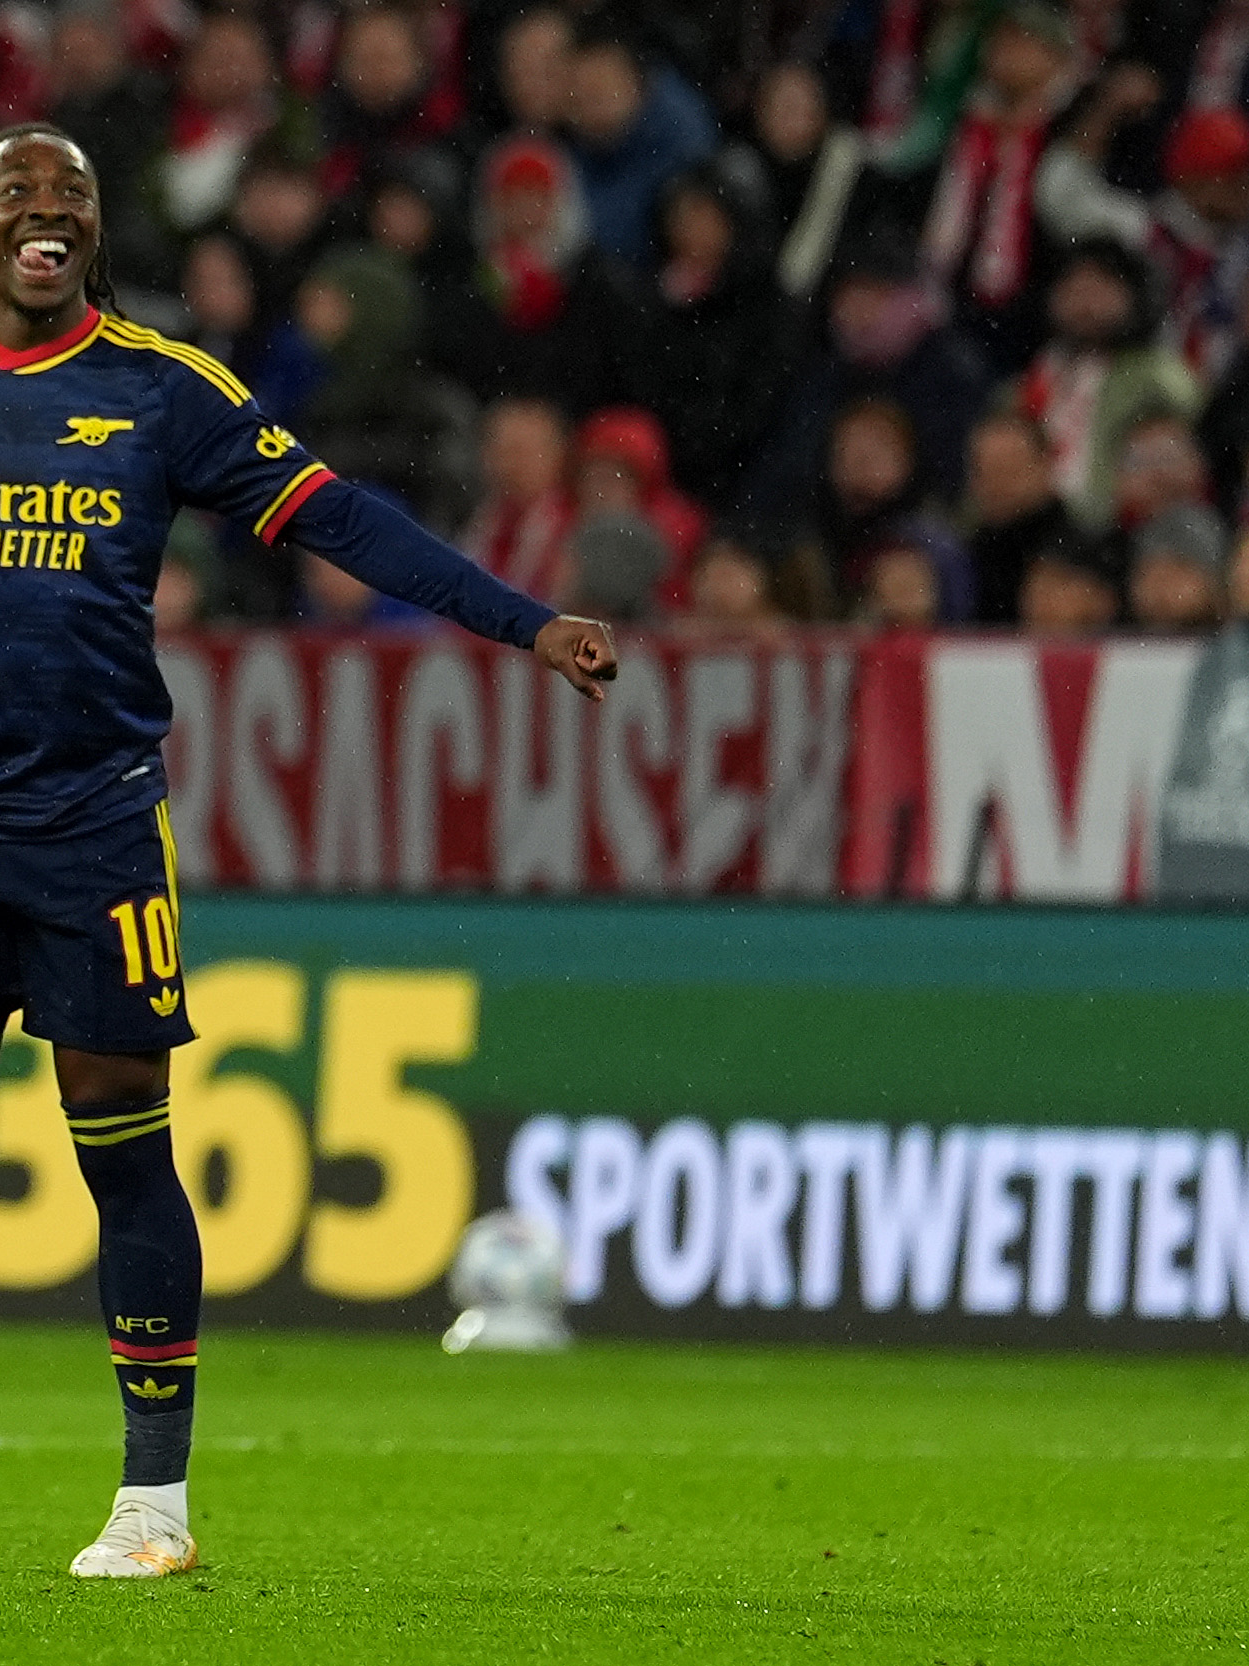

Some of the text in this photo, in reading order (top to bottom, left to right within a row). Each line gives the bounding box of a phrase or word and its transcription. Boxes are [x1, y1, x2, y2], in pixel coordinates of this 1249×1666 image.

[108, 895, 178, 987] 10
[505, 1112, 1249, 1322] SPORTWETTEN
[115, 1314, 169, 1334] AFC
